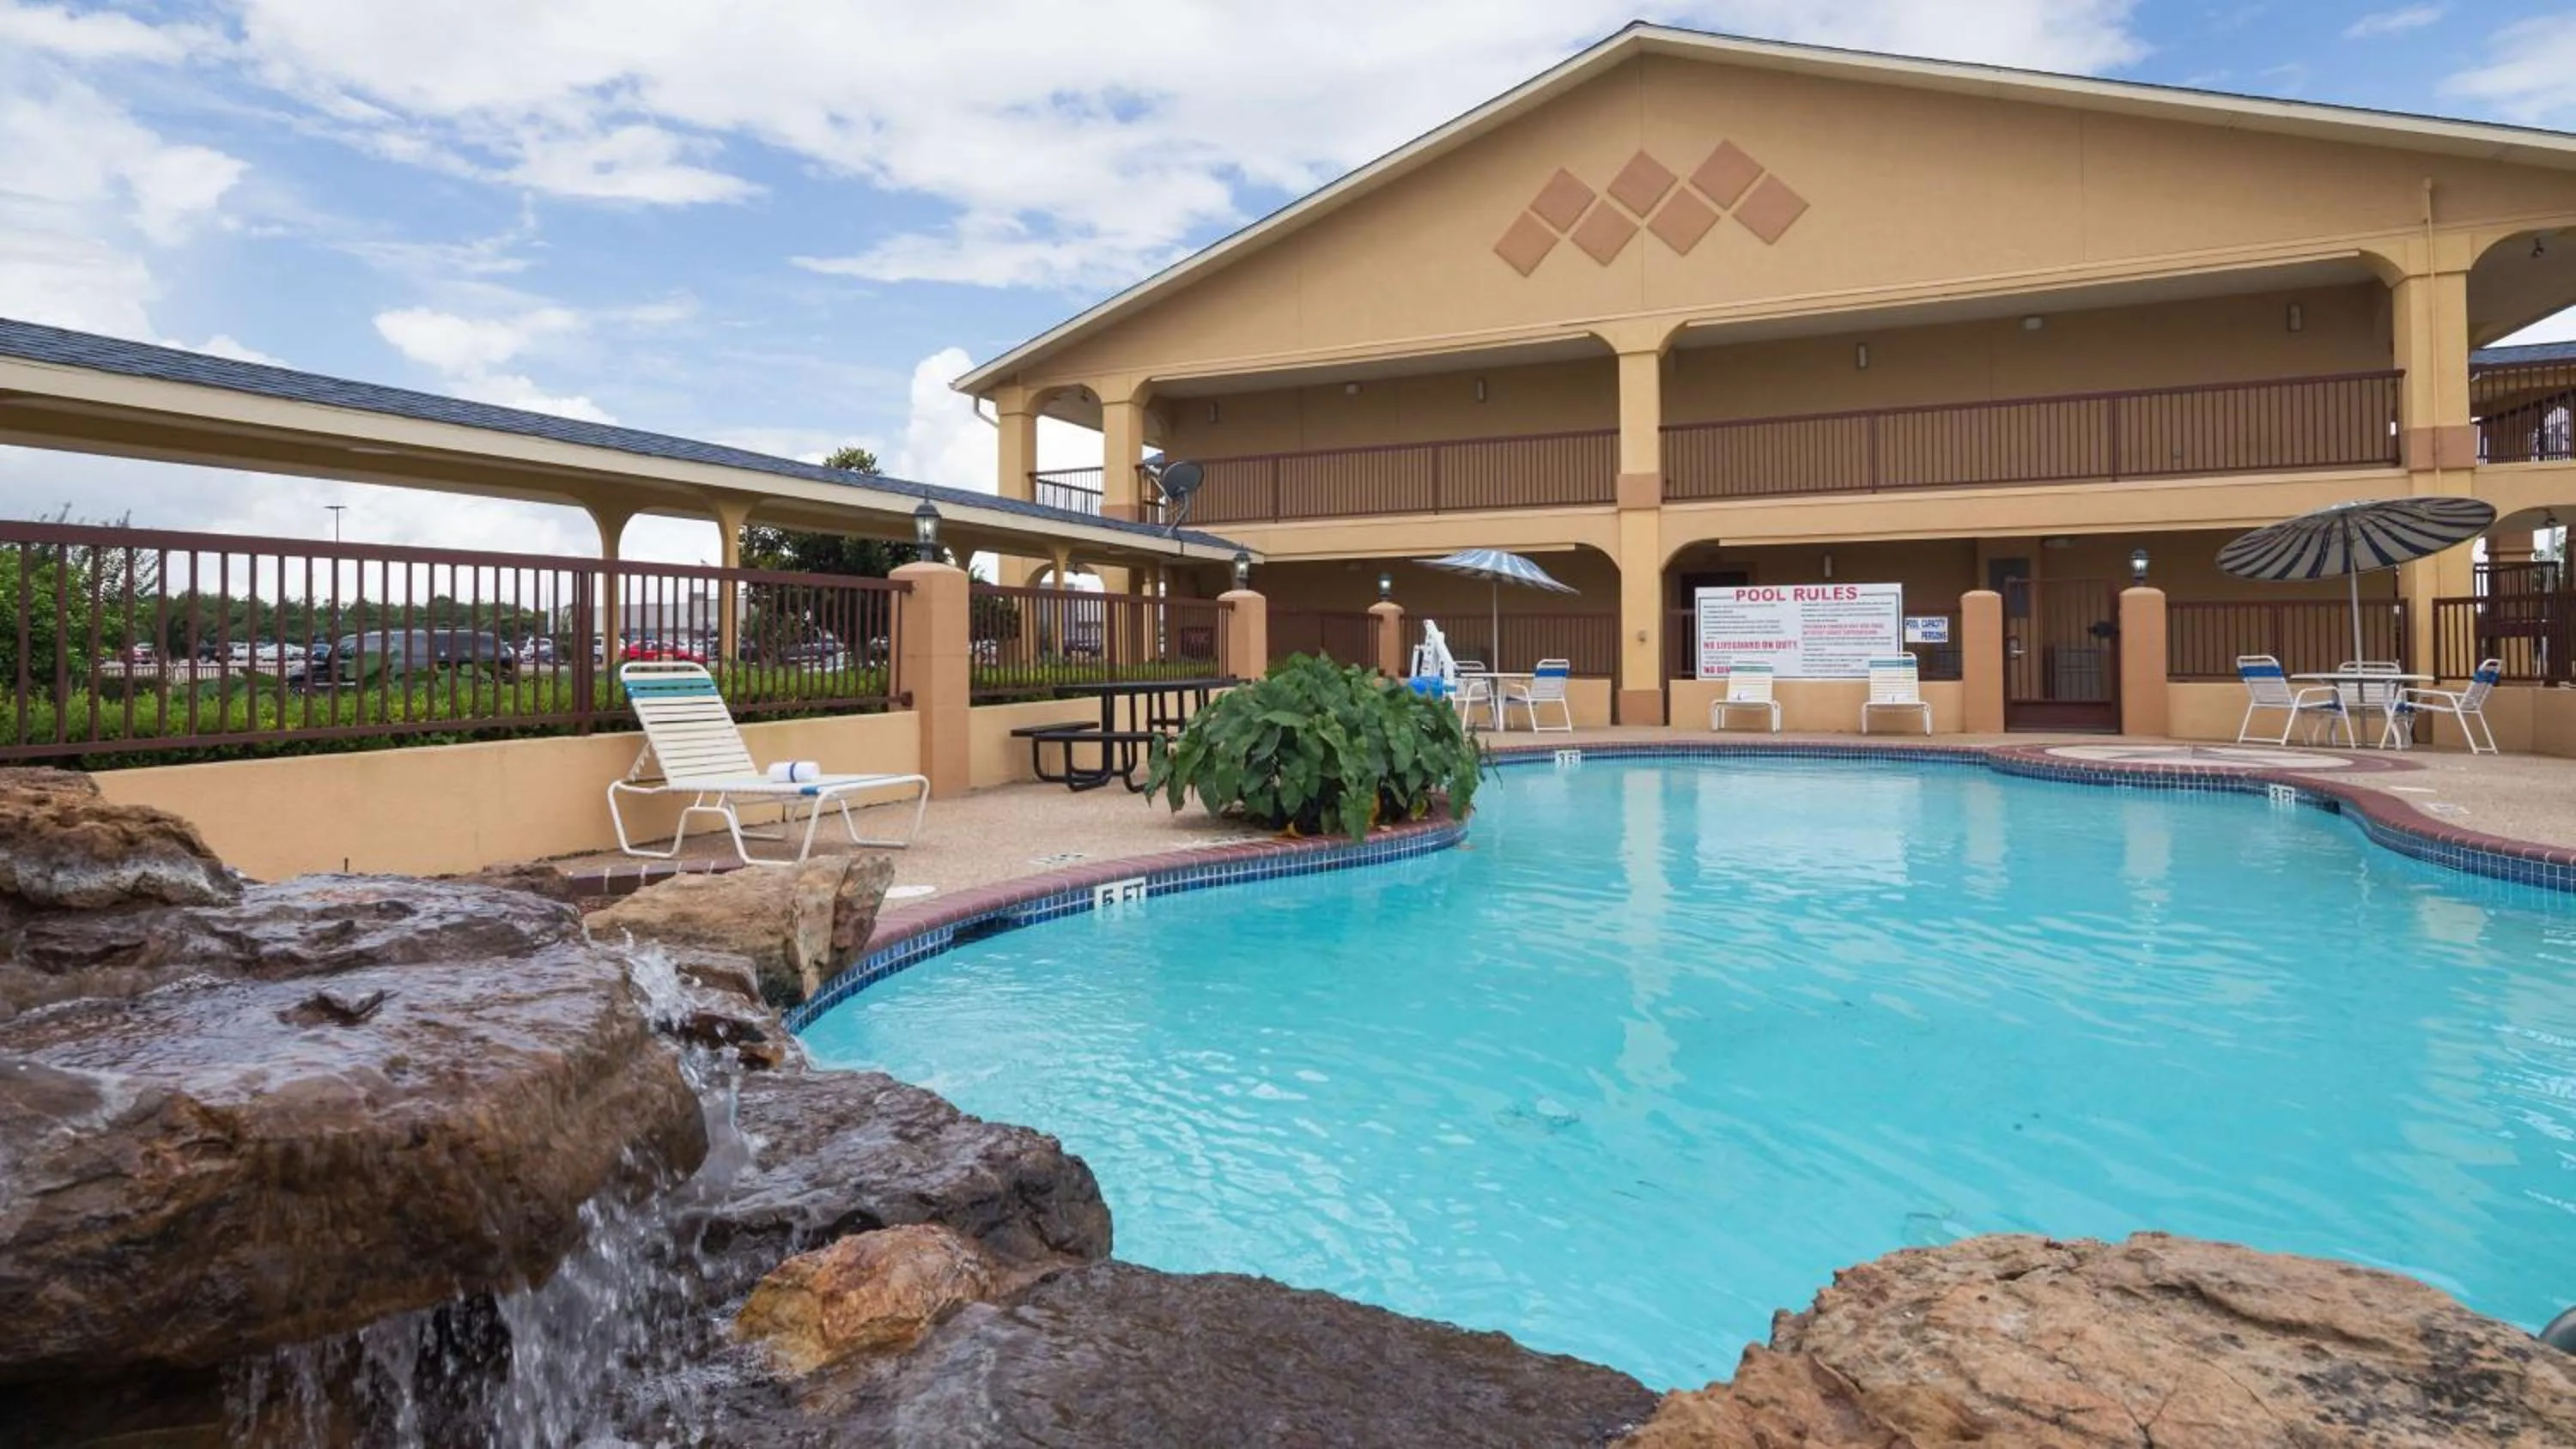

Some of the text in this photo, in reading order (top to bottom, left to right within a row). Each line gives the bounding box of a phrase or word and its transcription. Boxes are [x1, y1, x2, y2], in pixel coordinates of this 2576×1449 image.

[1735, 585, 1858, 602] POOL RULES
[1102, 882, 1145, 906] 5 FT
